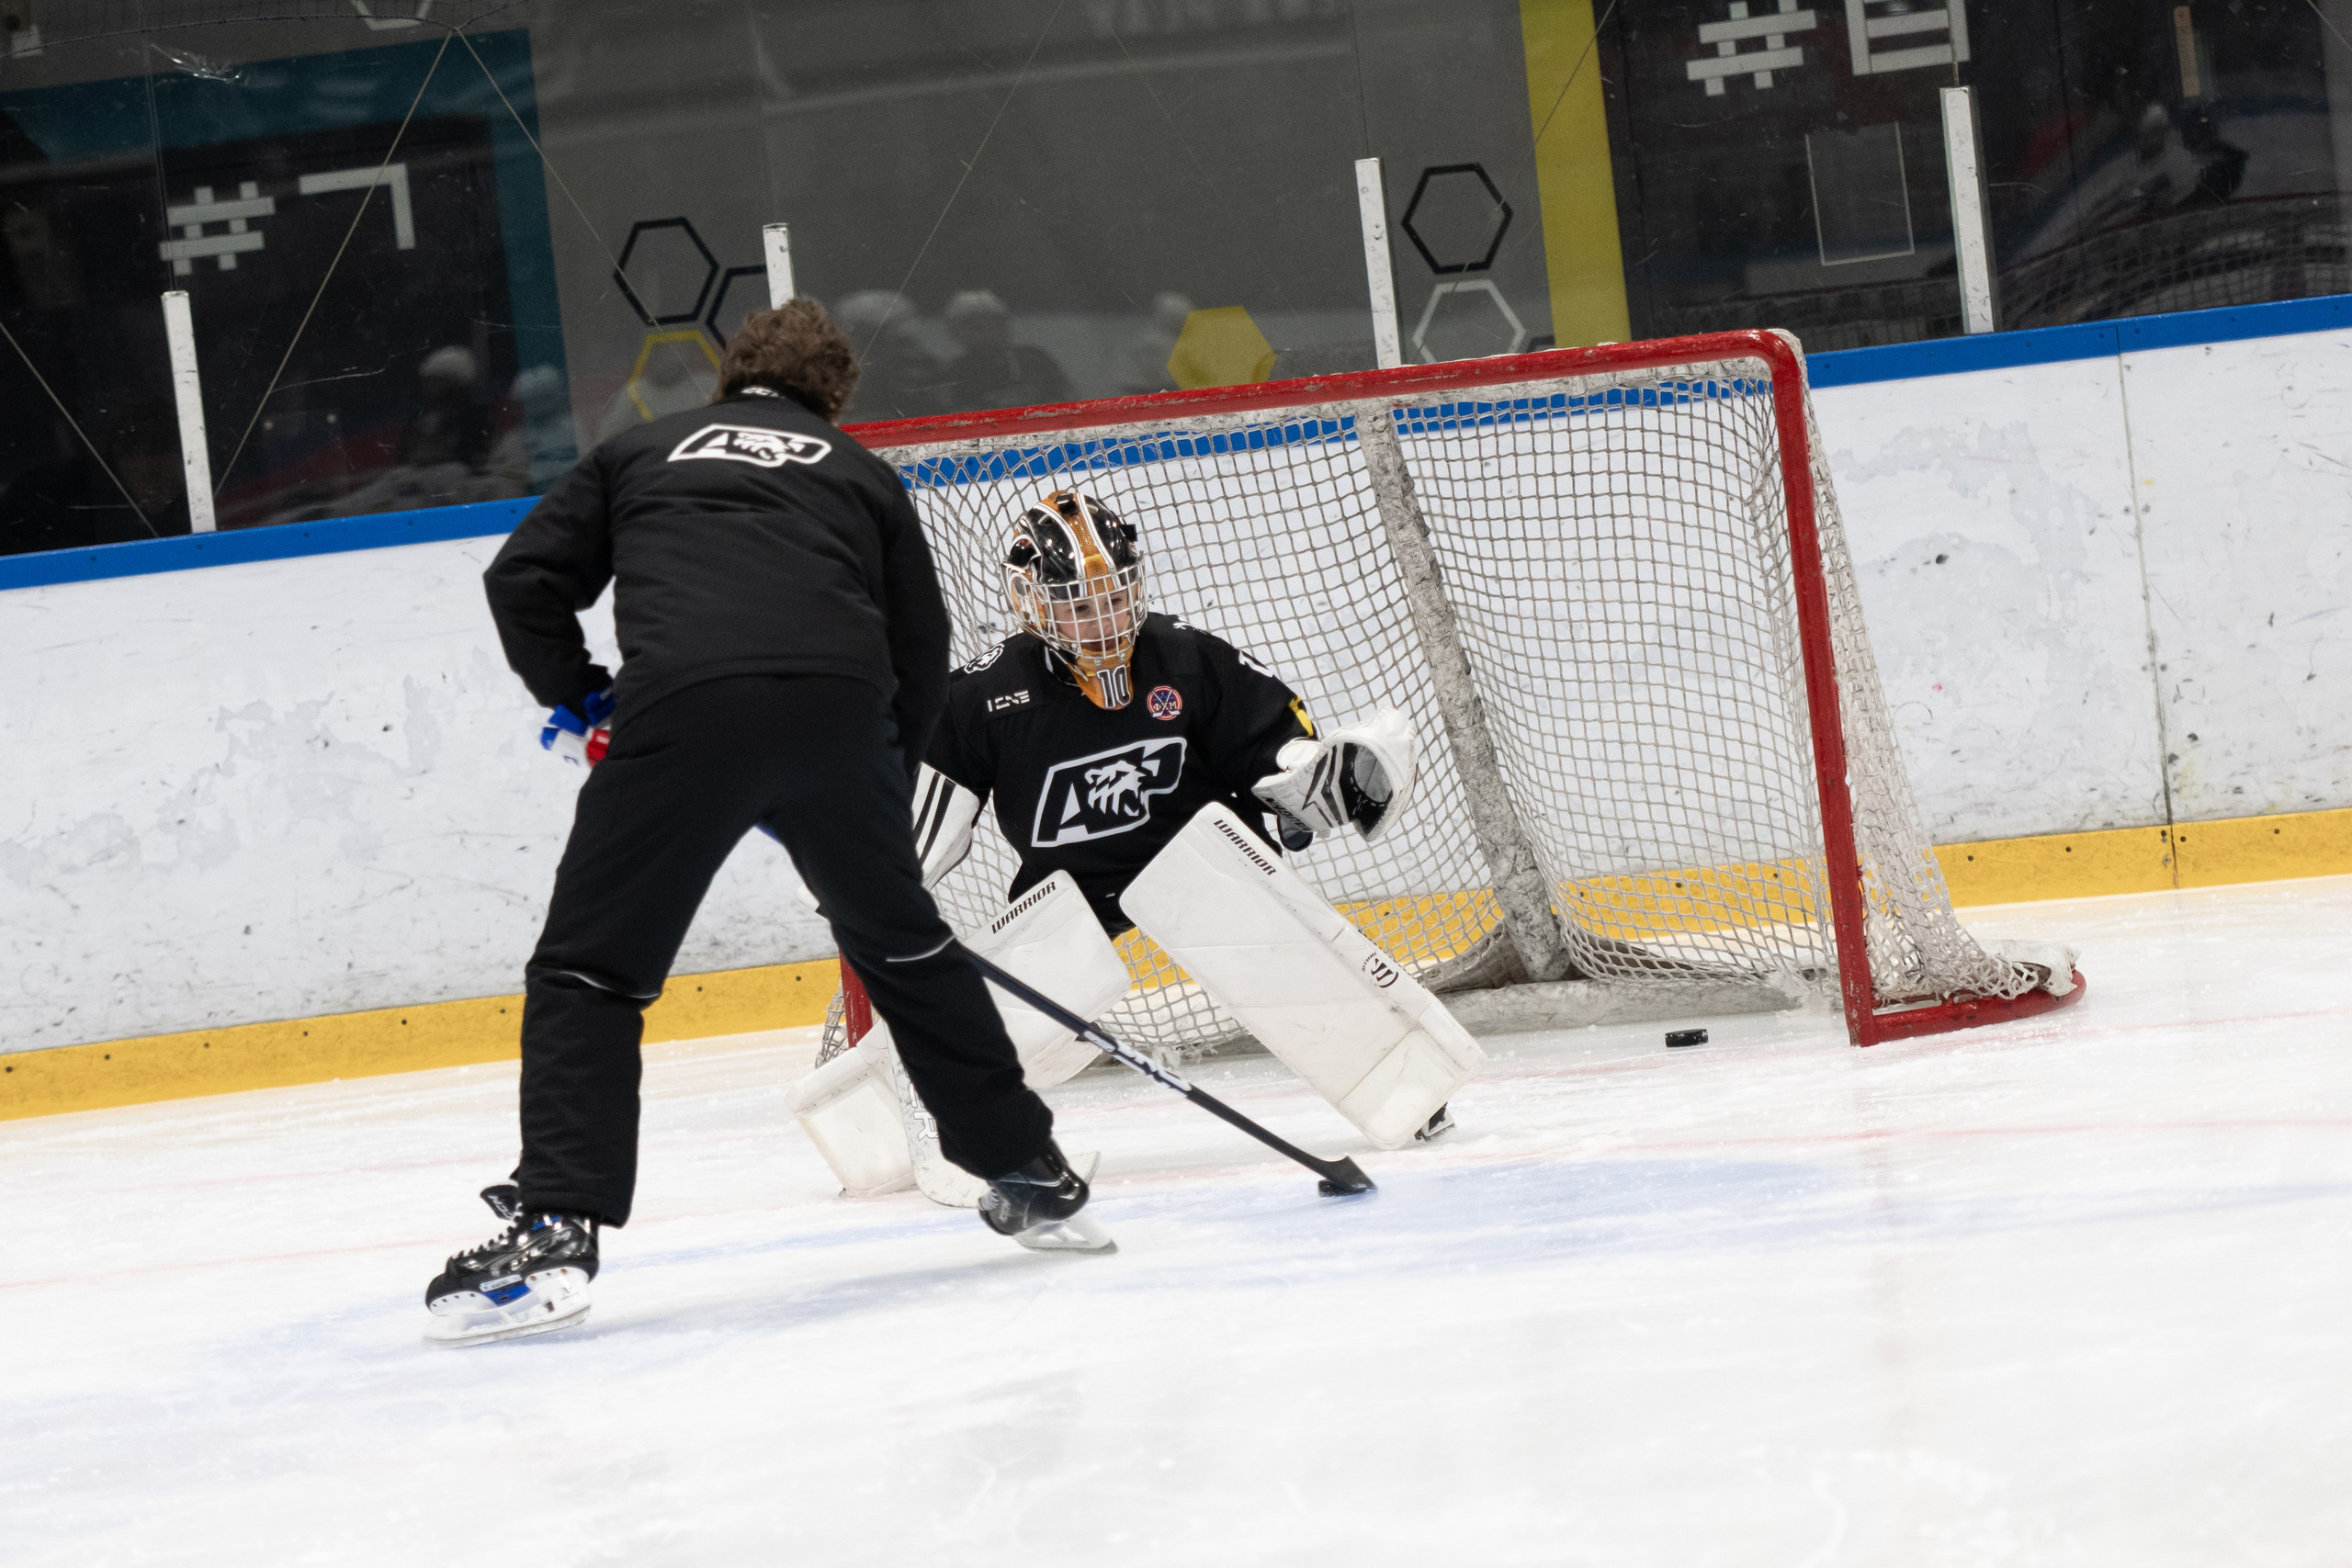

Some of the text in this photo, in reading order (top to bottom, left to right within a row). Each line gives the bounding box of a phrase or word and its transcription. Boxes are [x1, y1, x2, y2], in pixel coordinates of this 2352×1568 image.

[158, 162, 415, 276] #7
[1097, 664, 1131, 709] 10
[1152, 702, 1178, 711] ФХМ
[1213, 819, 1277, 876] WARRIOR
[991, 881, 1057, 935] WARRIOR
